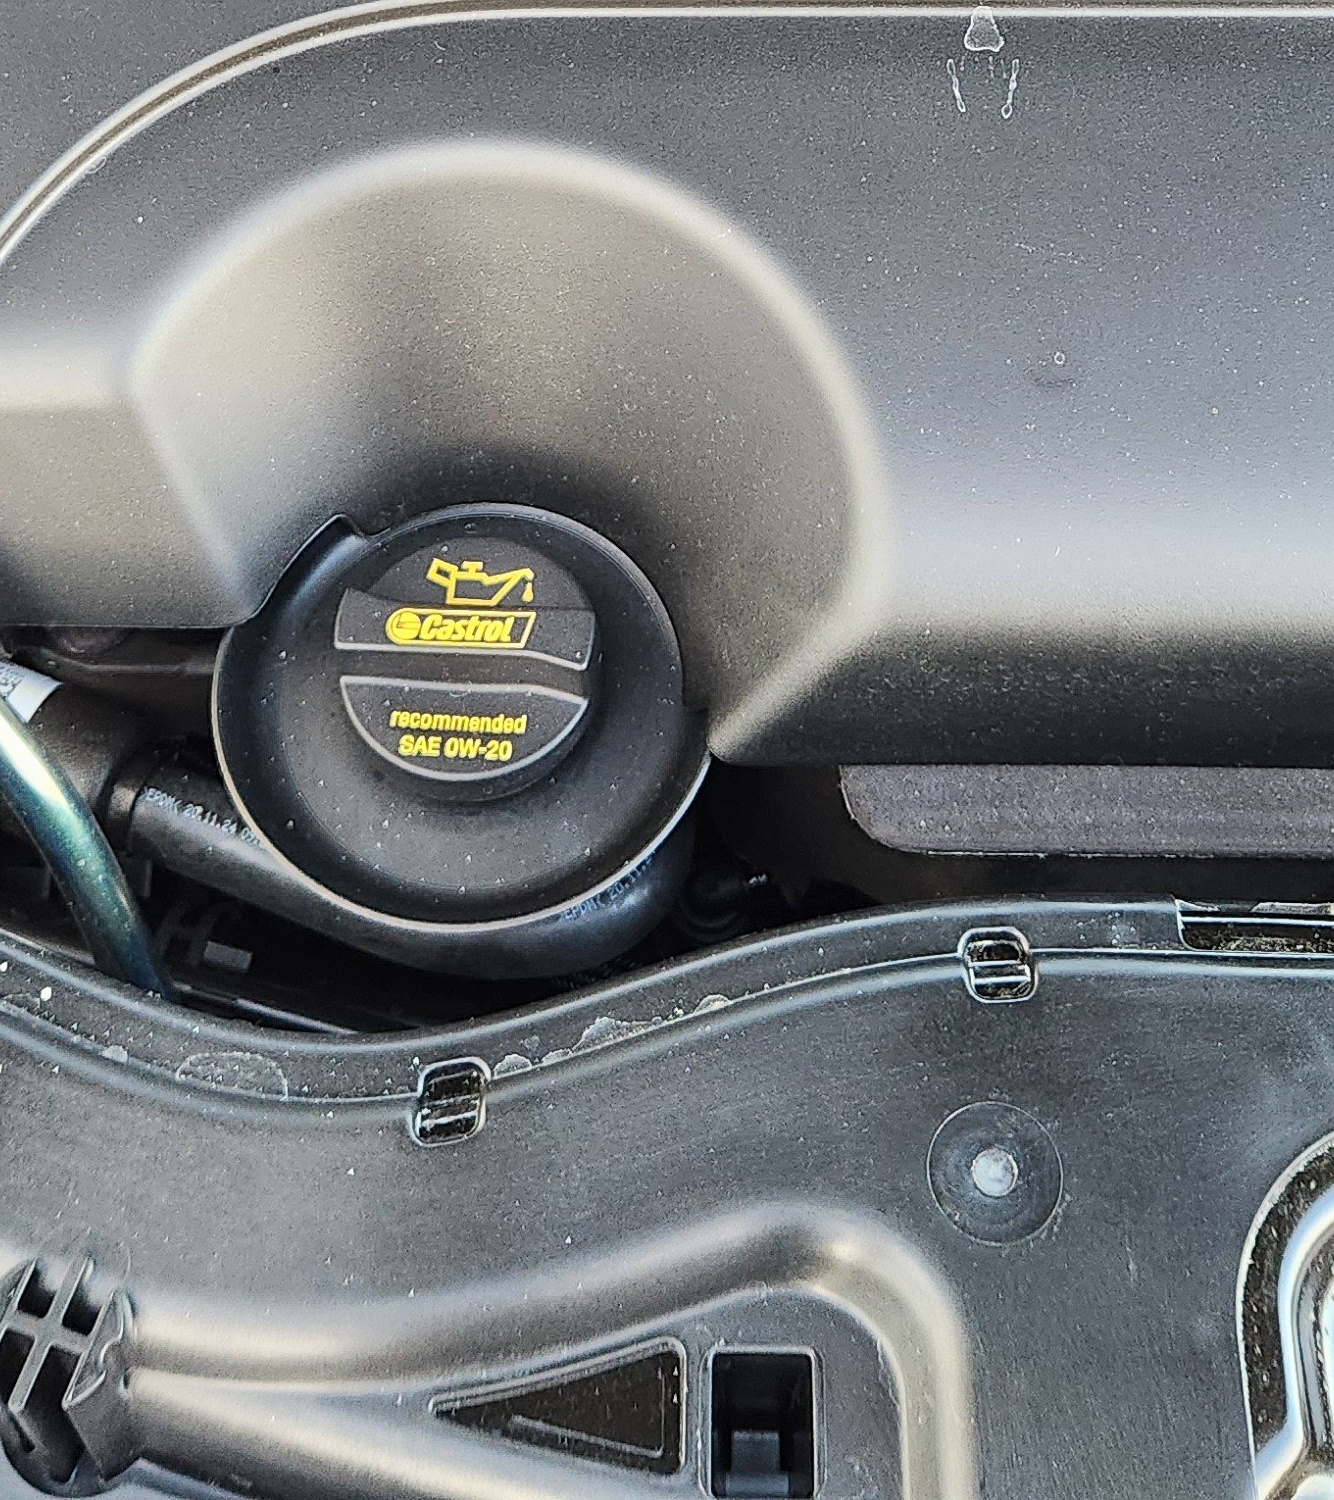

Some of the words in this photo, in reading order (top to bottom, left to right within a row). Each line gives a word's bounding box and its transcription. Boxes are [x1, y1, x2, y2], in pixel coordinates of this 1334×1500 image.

[418, 613, 515, 642] Castrol
[389, 709, 528, 735] recommended
[398, 734, 442, 757] SAE
[443, 738, 514, 762] 0W-20
